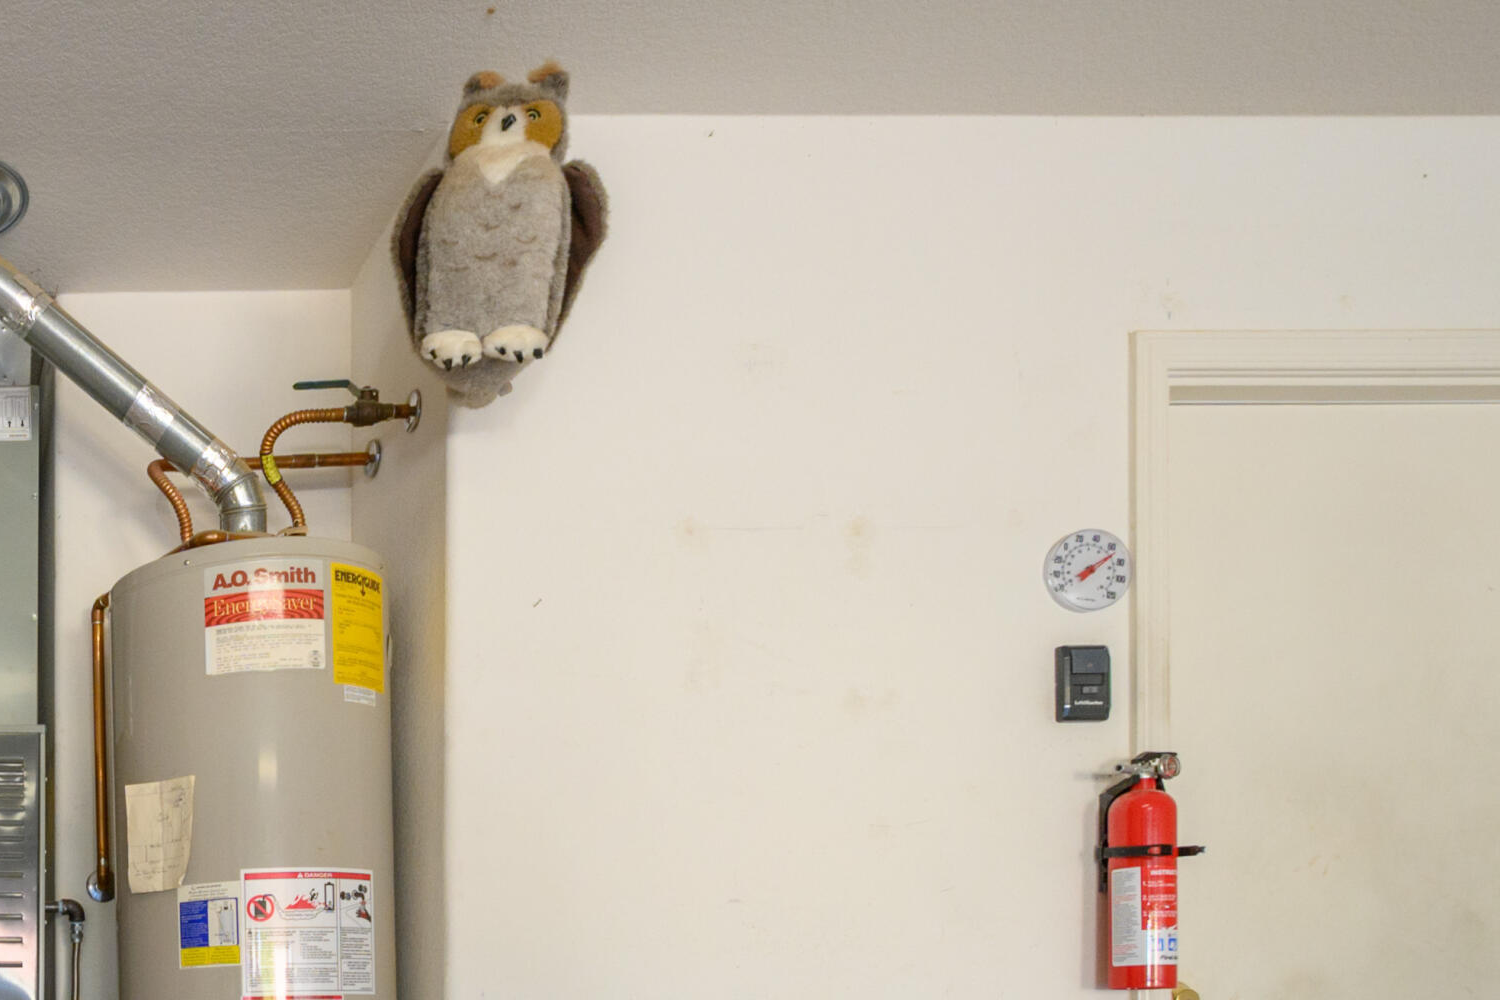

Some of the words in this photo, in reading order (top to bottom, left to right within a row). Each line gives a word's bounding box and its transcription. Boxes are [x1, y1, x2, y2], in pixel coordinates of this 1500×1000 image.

[212, 570, 250, 591] A.O.
[253, 566, 316, 585] Smith
[213, 597, 268, 617] Ener
[272, 594, 316, 611] aver
